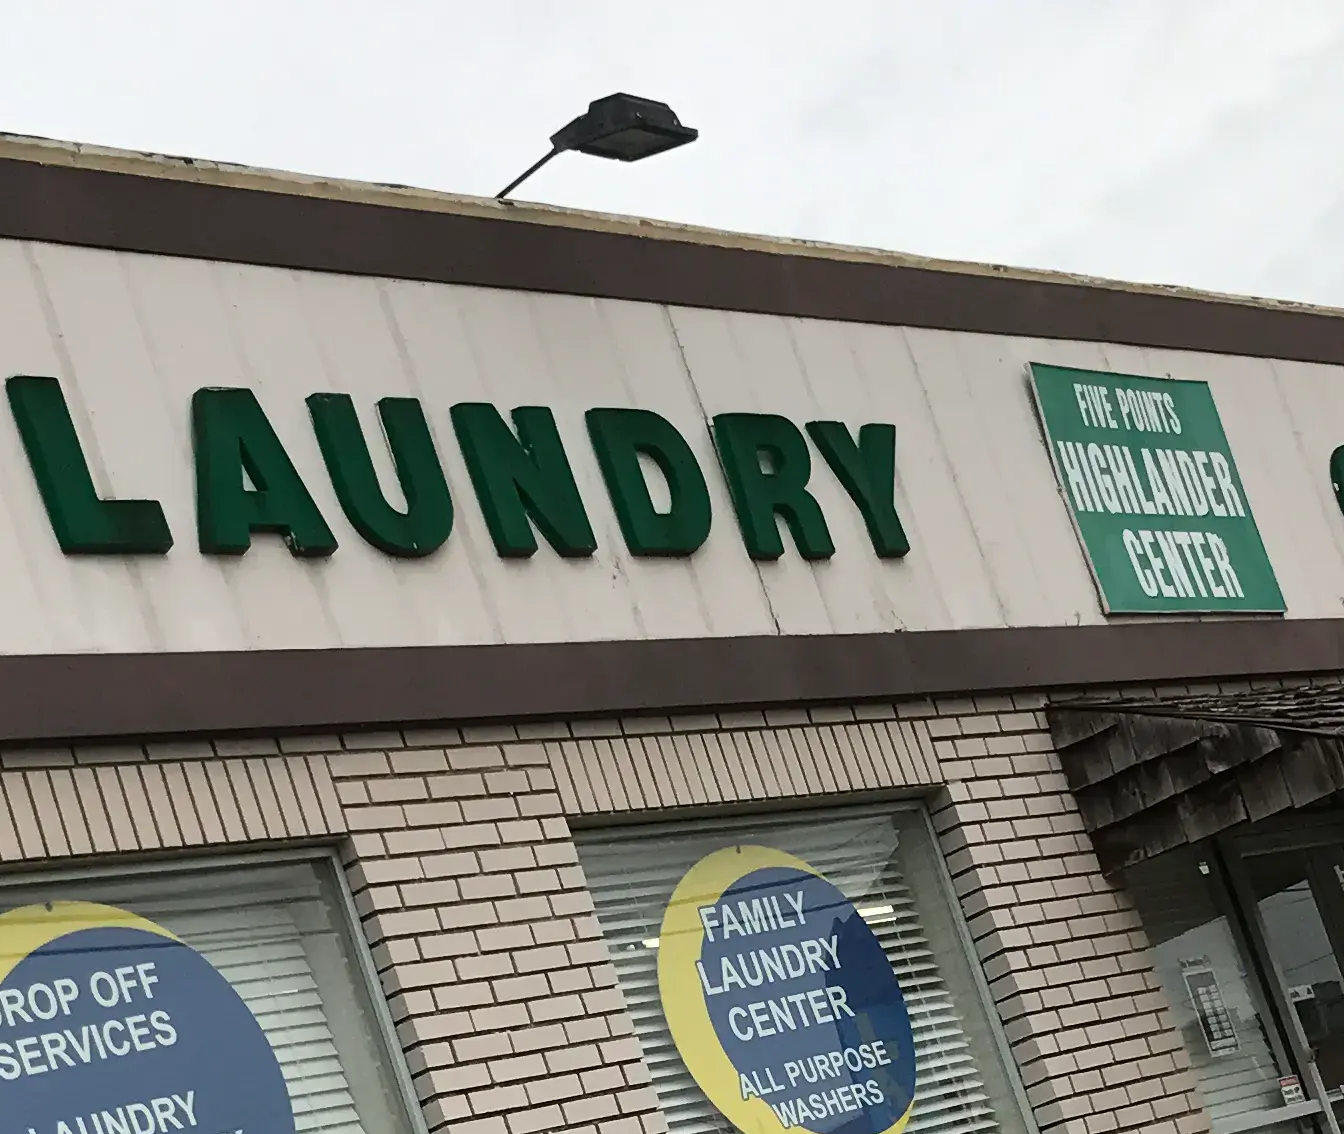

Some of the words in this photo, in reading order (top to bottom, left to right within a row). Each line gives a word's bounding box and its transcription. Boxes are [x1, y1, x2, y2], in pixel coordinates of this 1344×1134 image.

[1073, 383, 1118, 429] FIVE
[1116, 387, 1182, 435] POINTS
[5, 375, 911, 560] LAUNDRY
[1057, 440, 1246, 517] HIGHLANDER
[1122, 528, 1245, 598] CENTER
[697, 890, 808, 943] FAMILY
[90, 962, 160, 1009] OFF
[695, 935, 843, 997] LAUNDRY
[728, 985, 856, 1042] CENTER
[738, 1065, 785, 1101] ALL
[785, 1040, 892, 1088] PURPOSE
[772, 1080, 885, 1129] WASHERS
